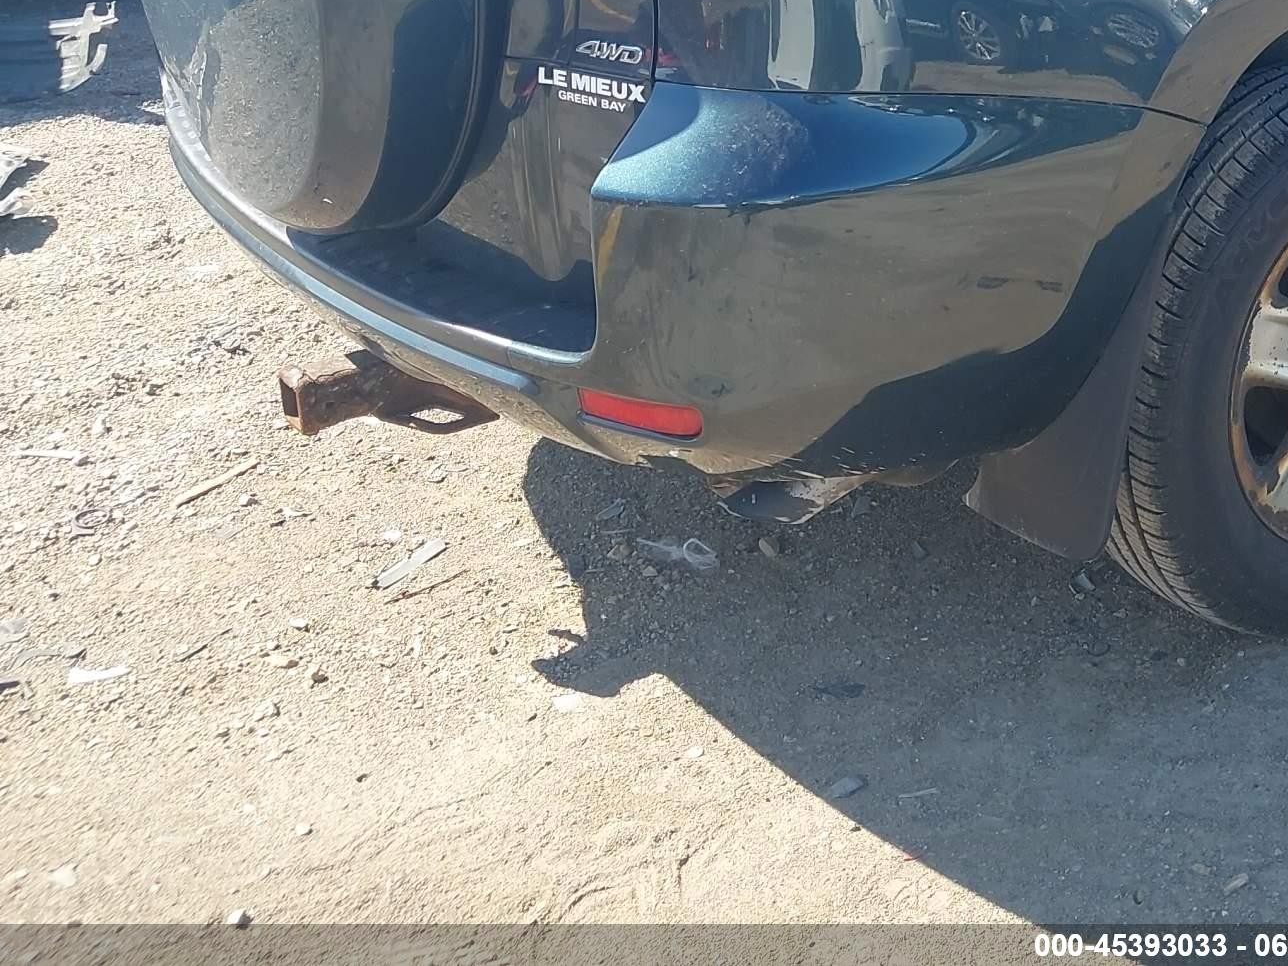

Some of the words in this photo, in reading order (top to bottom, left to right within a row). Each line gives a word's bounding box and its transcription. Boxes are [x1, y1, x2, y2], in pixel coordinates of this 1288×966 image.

[576, 40, 643, 64] 4WD
[538, 66, 567, 88] LE
[571, 72, 646, 103] MIEUX
[558, 90, 598, 107] GREEN
[601, 97, 627, 113] BAY
